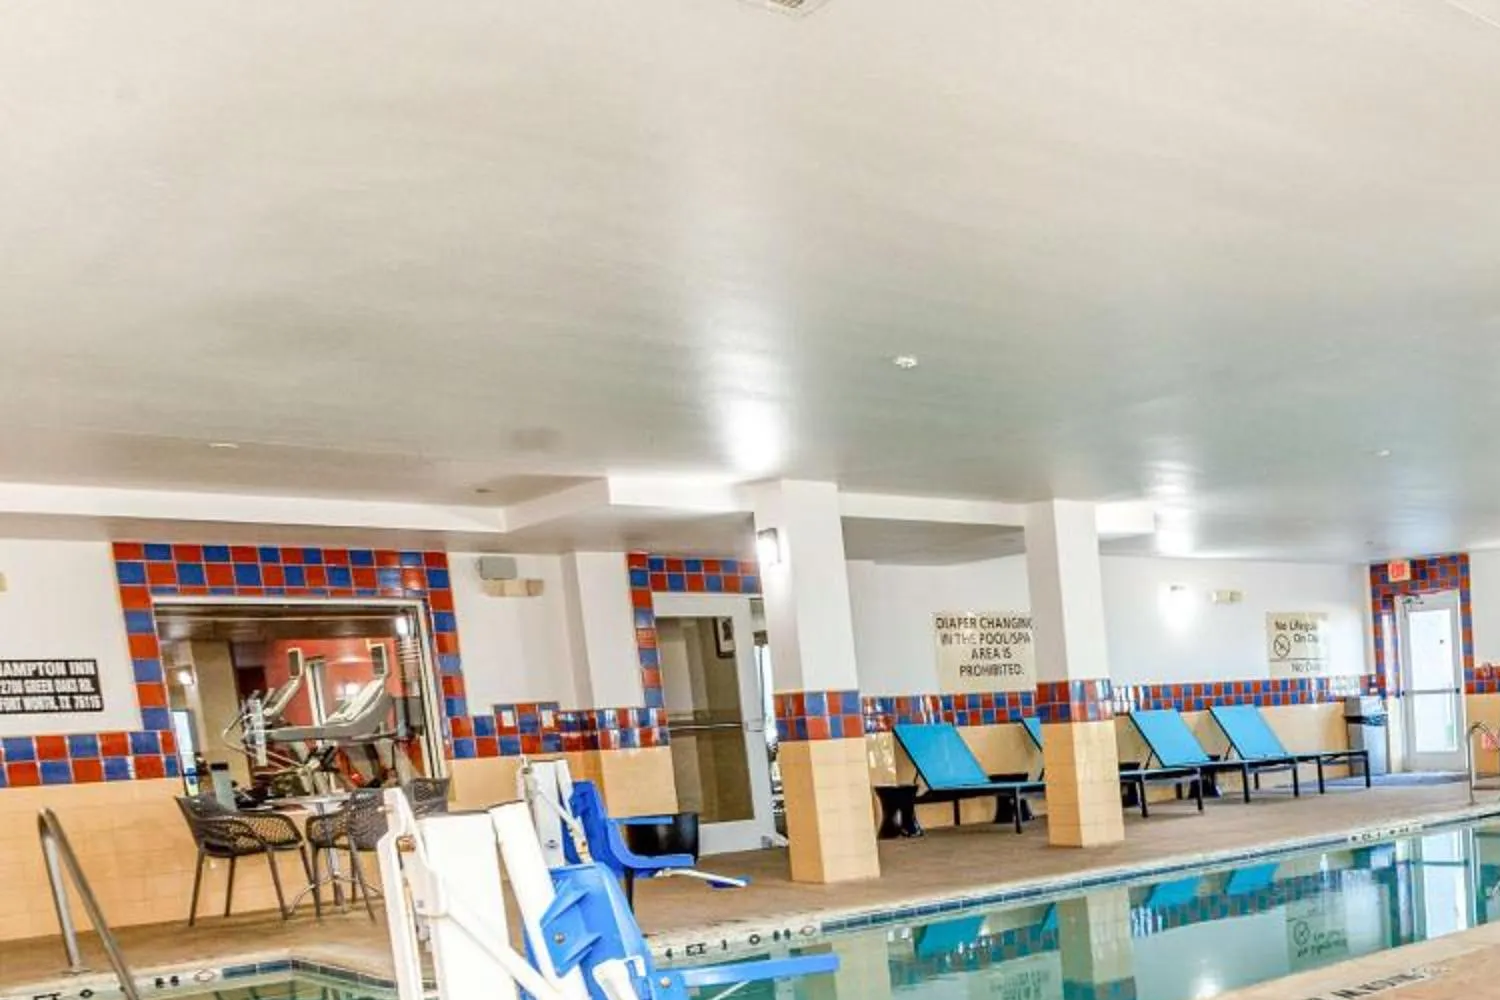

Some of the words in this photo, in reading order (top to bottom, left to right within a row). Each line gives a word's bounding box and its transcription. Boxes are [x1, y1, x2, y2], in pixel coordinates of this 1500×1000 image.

[936, 617, 977, 629] DIAPER
[979, 617, 1032, 629] CHANGIN
[971, 647, 1001, 660] AREA
[69, 661, 95, 676] INN
